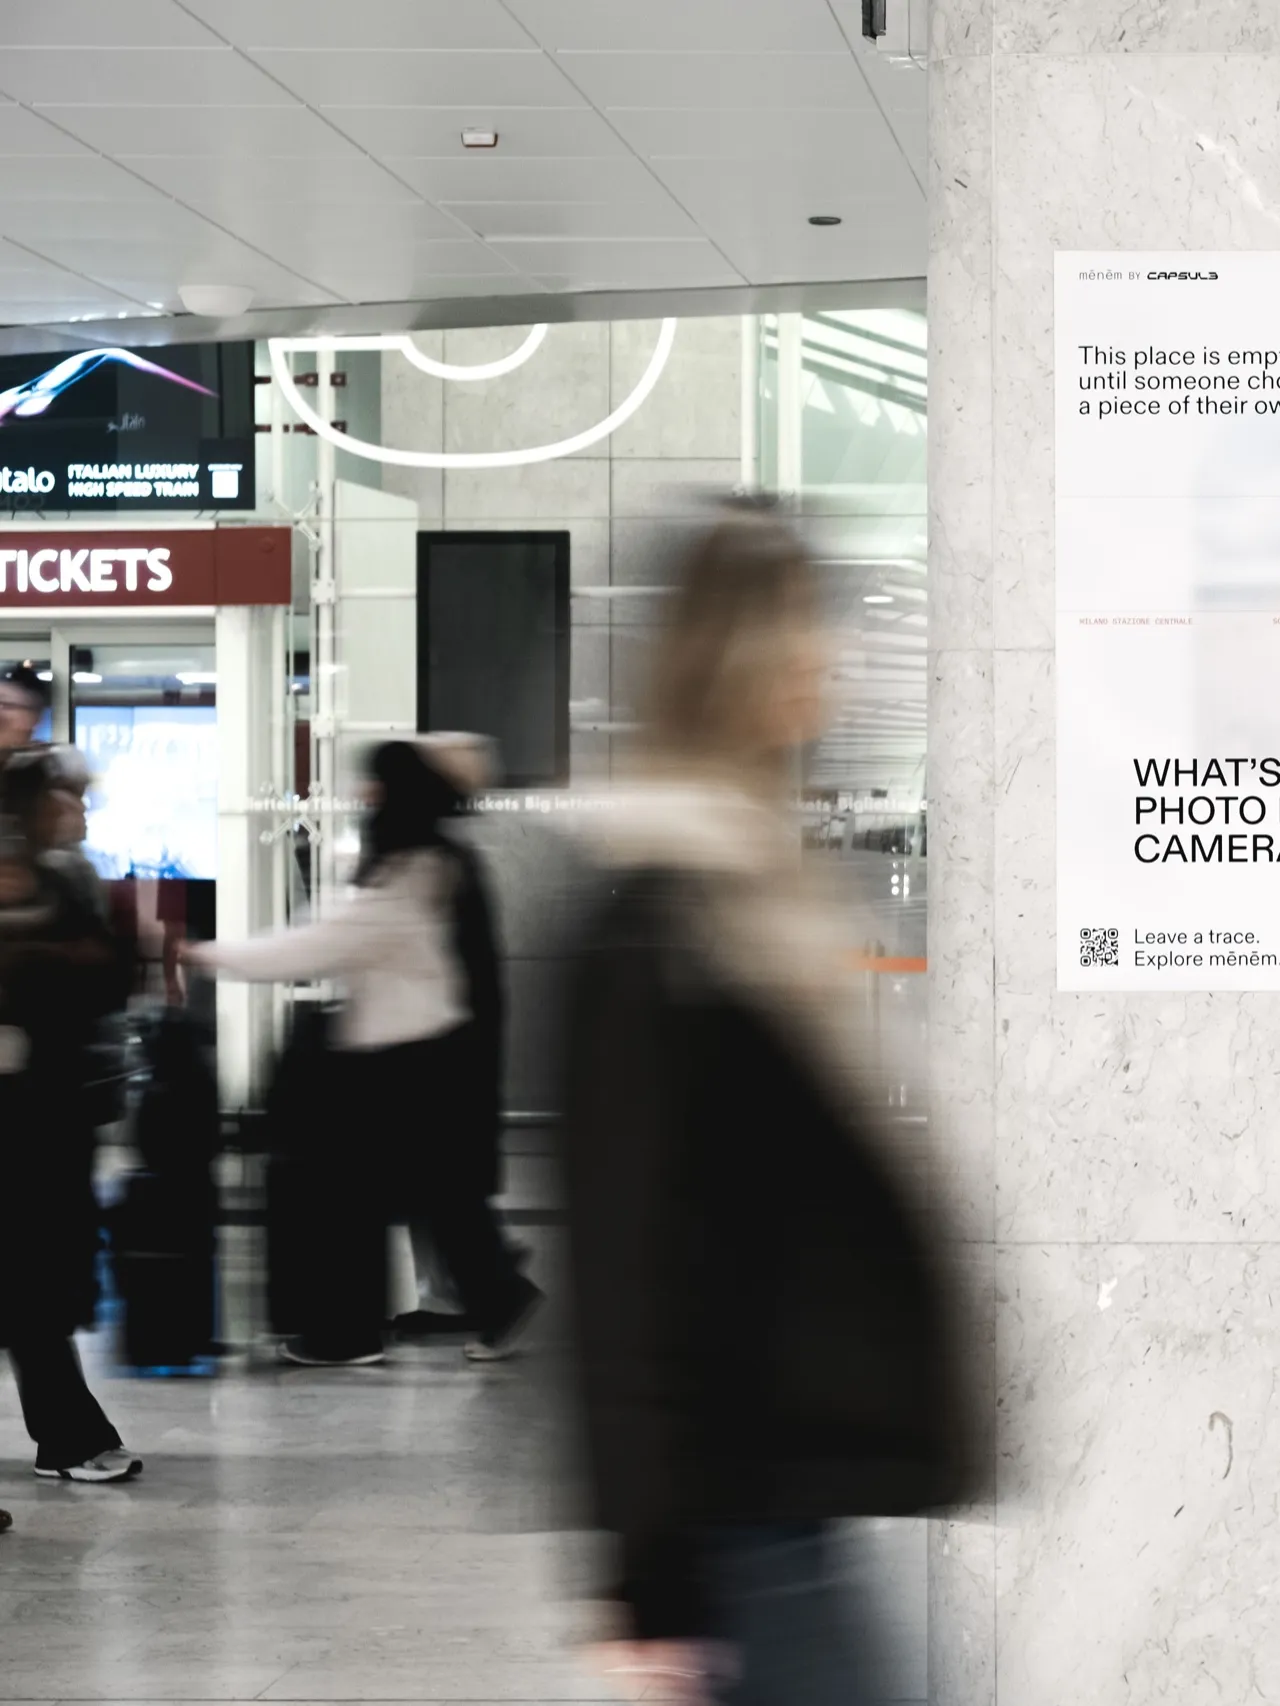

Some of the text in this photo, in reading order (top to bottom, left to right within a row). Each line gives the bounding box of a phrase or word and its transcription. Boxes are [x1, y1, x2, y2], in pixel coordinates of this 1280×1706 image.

[1129, 272, 1140, 280] BY
[1079, 346, 1125, 365] This
[1135, 346, 1195, 370] place
[1204, 347, 1220, 365] is
[1080, 371, 1126, 390] until
[1135, 376, 1239, 390] someone
[1079, 401, 1089, 414] a
[1100, 396, 1160, 419] piece
[1169, 395, 1189, 414] of
[1197, 396, 1247, 414] their
[0, 467, 56, 493] talo
[68, 464, 200, 480] ITALIAN LUXURY
[68, 481, 200, 498] HIGH SPEED TRAIN
[1136, 796, 1266, 825] PHOTO
[1134, 929, 1259, 945] Leave a trace.
[1135, 951, 1203, 969] Explore
